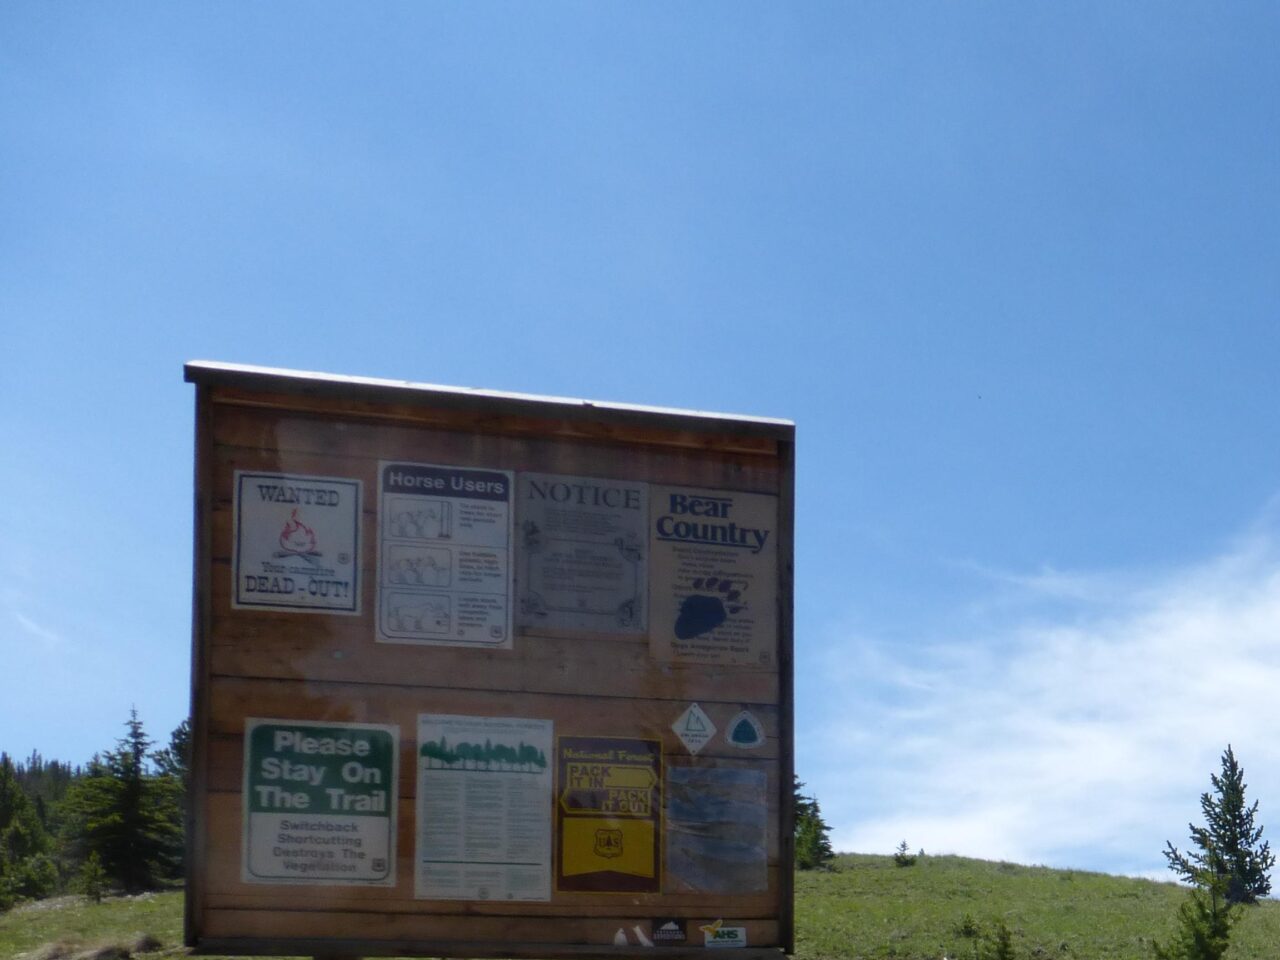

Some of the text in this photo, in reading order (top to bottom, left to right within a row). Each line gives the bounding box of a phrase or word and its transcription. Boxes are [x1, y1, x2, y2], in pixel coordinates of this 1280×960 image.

[389, 472, 505, 494] Horse Users
[257, 484, 340, 507] WANTED
[527, 480, 641, 510] NOTICE
[669, 493, 733, 519] Bear
[656, 515, 770, 553] Country
[245, 575, 295, 594] DEAD
[308, 578, 349, 598] OUT!
[273, 730, 371, 757] Please
[563, 748, 615, 762] National
[261, 757, 382, 785] Stay On
[570, 766, 612, 778] PACK
[569, 776, 605, 788] IT IN
[254, 785, 386, 812] The Trail
[608, 789, 648, 802] PACK
[601, 800, 649, 813] IT OUT
[280, 820, 359, 833] Switchback
[277, 833, 362, 848] Shortcutting
[273, 847, 367, 860] Destroys The
[283, 861, 357, 873] Vegetation
[713, 929, 738, 939] AHS
